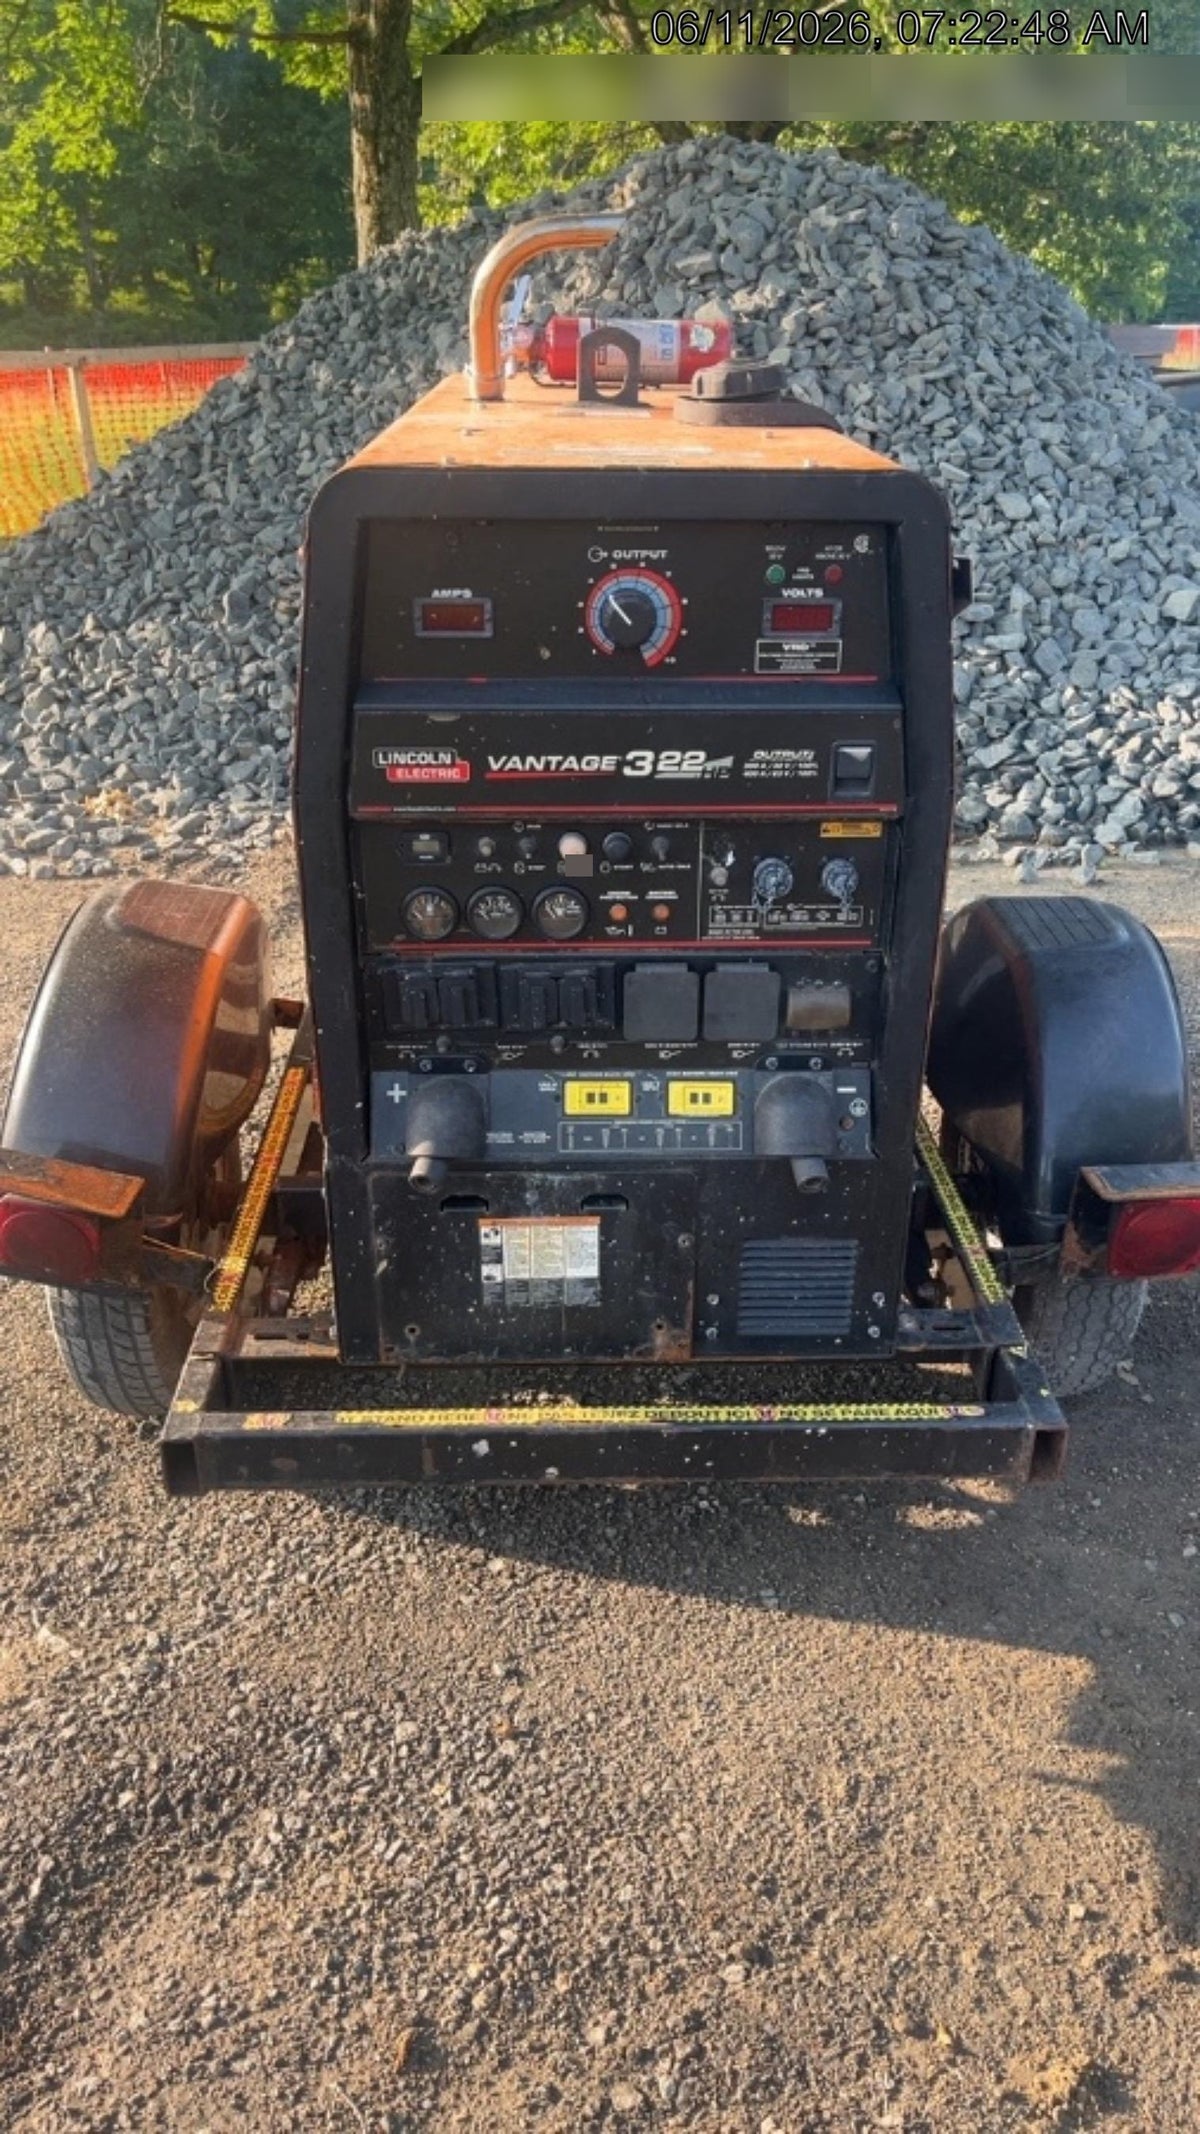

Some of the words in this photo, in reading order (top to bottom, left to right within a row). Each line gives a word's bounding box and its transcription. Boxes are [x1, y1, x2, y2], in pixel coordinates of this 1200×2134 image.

[612, 550, 668, 559] OUTPUT
[431, 589, 472, 598] AMPS
[781, 588, 824, 598] VOLTS
[378, 751, 452, 765] LINCOLN
[623, 750, 707, 776] 322
[396, 767, 461, 779] ELECTRIC
